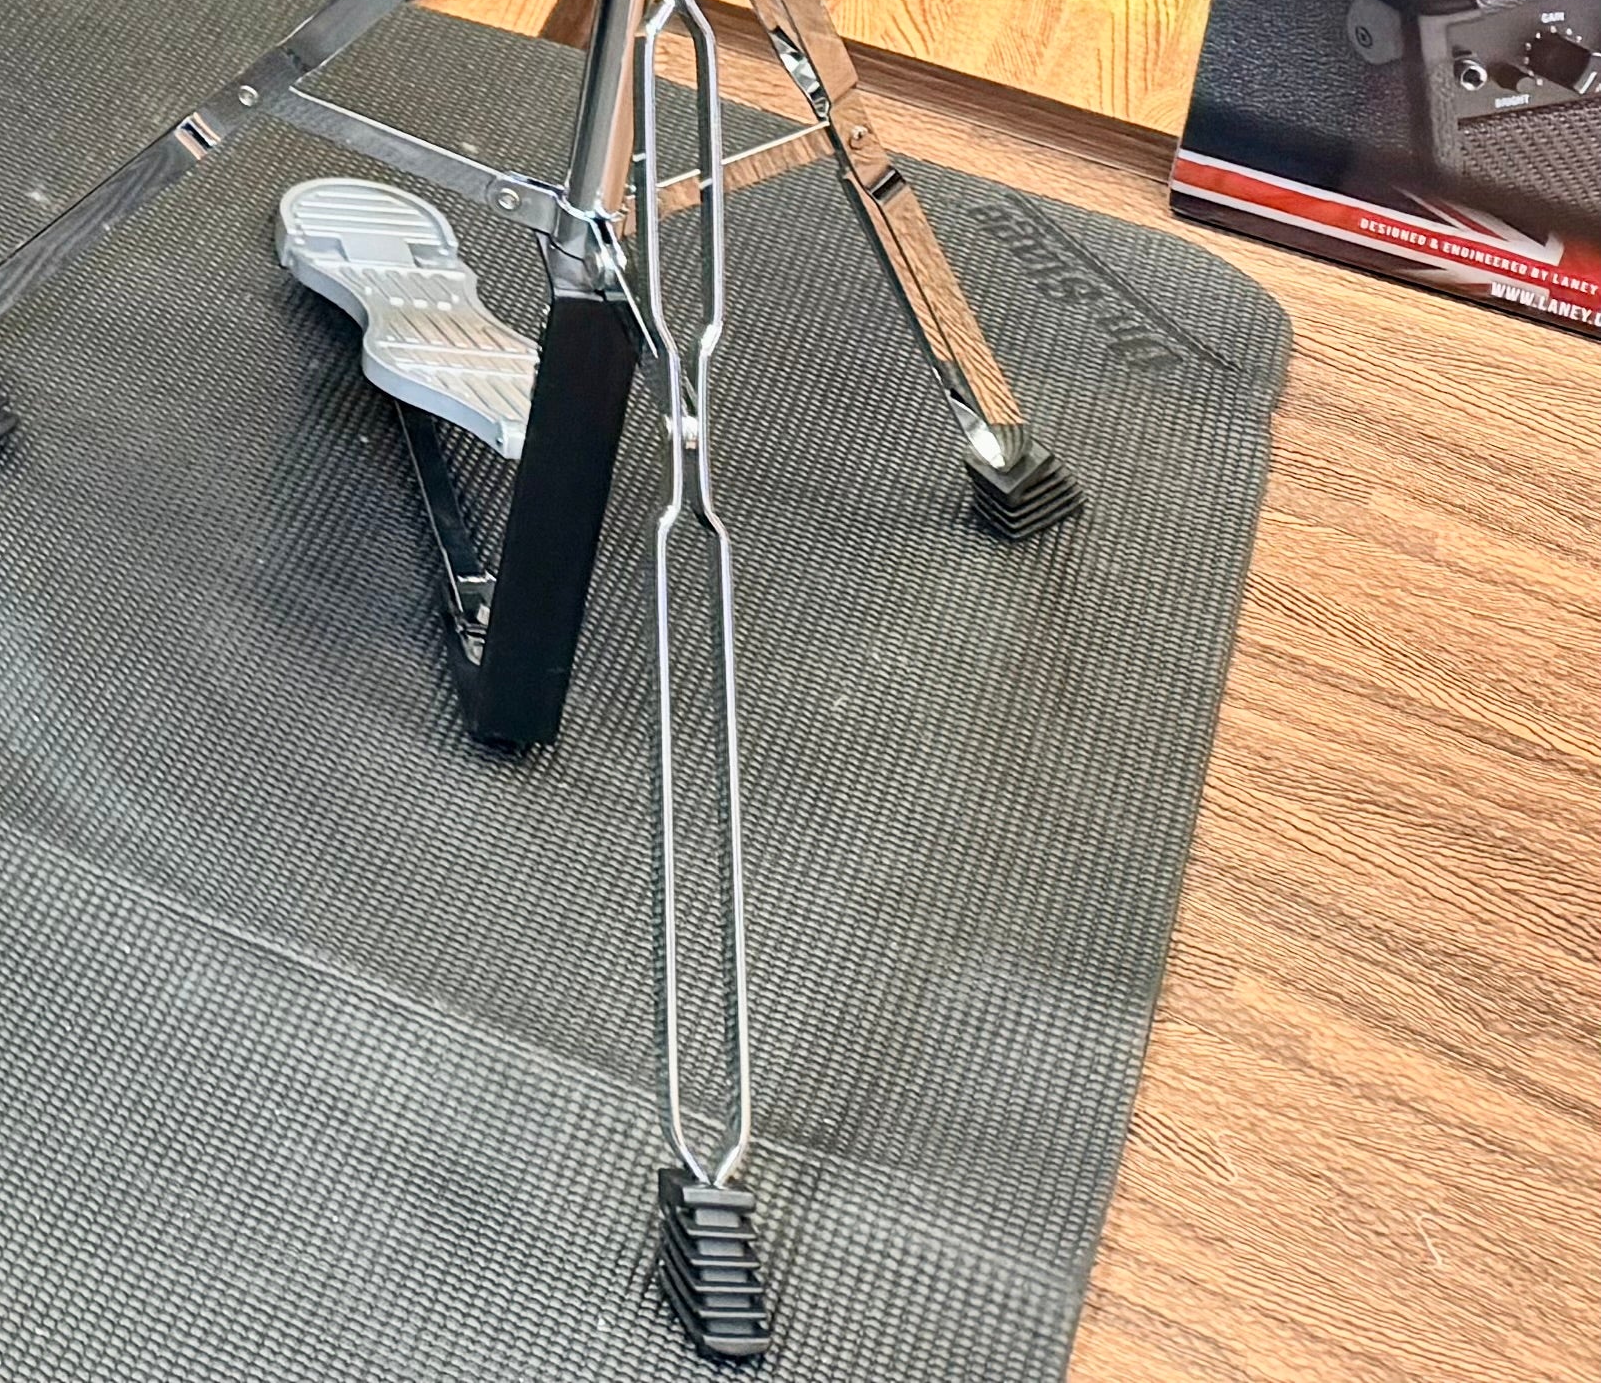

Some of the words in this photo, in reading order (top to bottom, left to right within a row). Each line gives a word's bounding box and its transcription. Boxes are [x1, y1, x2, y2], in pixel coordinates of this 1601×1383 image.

[1360, 217, 1427, 246] DESIGNED
[1430, 237, 1440, 251] &
[1442, 241, 1528, 278] ENGINEERED
[1531, 266, 1549, 282] BY
[1552, 272, 1599, 297] LANEY
